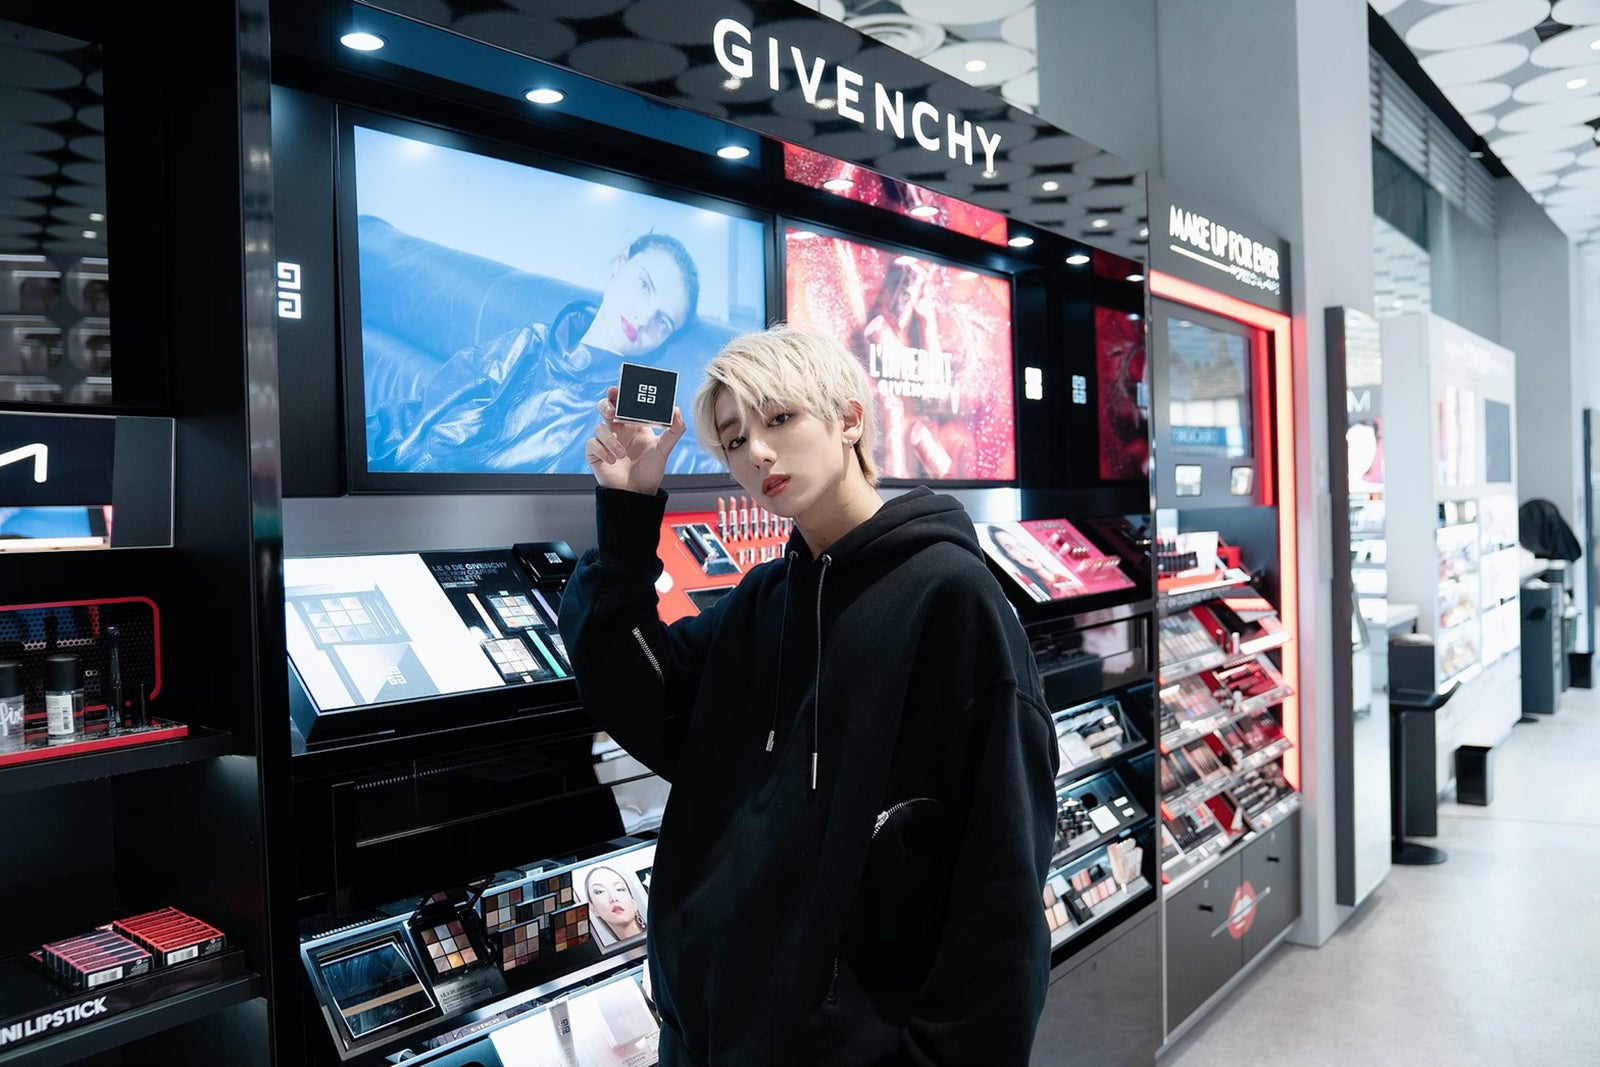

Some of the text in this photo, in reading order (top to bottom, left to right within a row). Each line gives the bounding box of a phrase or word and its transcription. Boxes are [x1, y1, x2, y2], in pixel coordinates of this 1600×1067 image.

[713, 18, 1001, 173] GIVENCHY
[1169, 204, 1210, 252] MAKE
[1210, 222, 1228, 258] UP
[1228, 230, 1253, 270] FOR
[465, 561, 508, 570] GIVENCHY
[24, 995, 108, 1037] LIPSTICK
